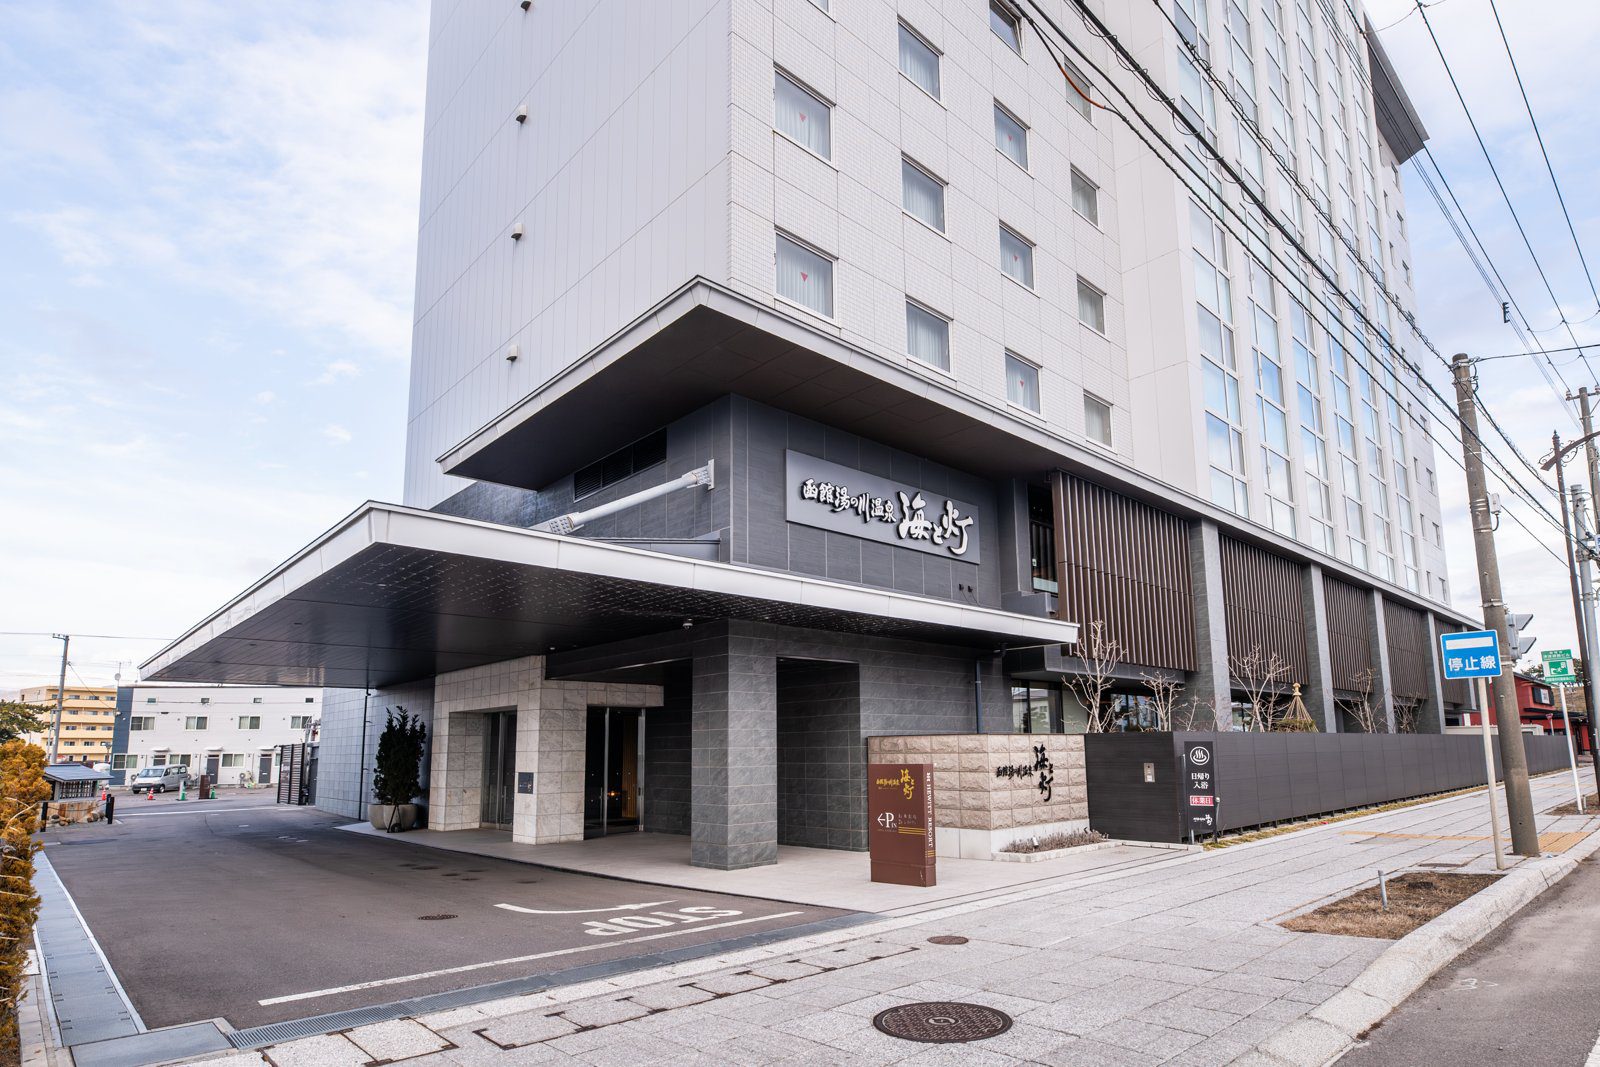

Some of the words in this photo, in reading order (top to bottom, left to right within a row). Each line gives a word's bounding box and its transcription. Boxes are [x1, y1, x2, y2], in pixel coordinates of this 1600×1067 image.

[802, 478, 897, 523] 函館湯の川温泉
[898, 491, 974, 556] 海と灯
[1448, 655, 1497, 672] 停止線
[1191, 772, 1210, 780] 日帰り
[1193, 781, 1209, 789] 入浴
[885, 812, 895, 828] P
[581, 906, 743, 936] STOP
